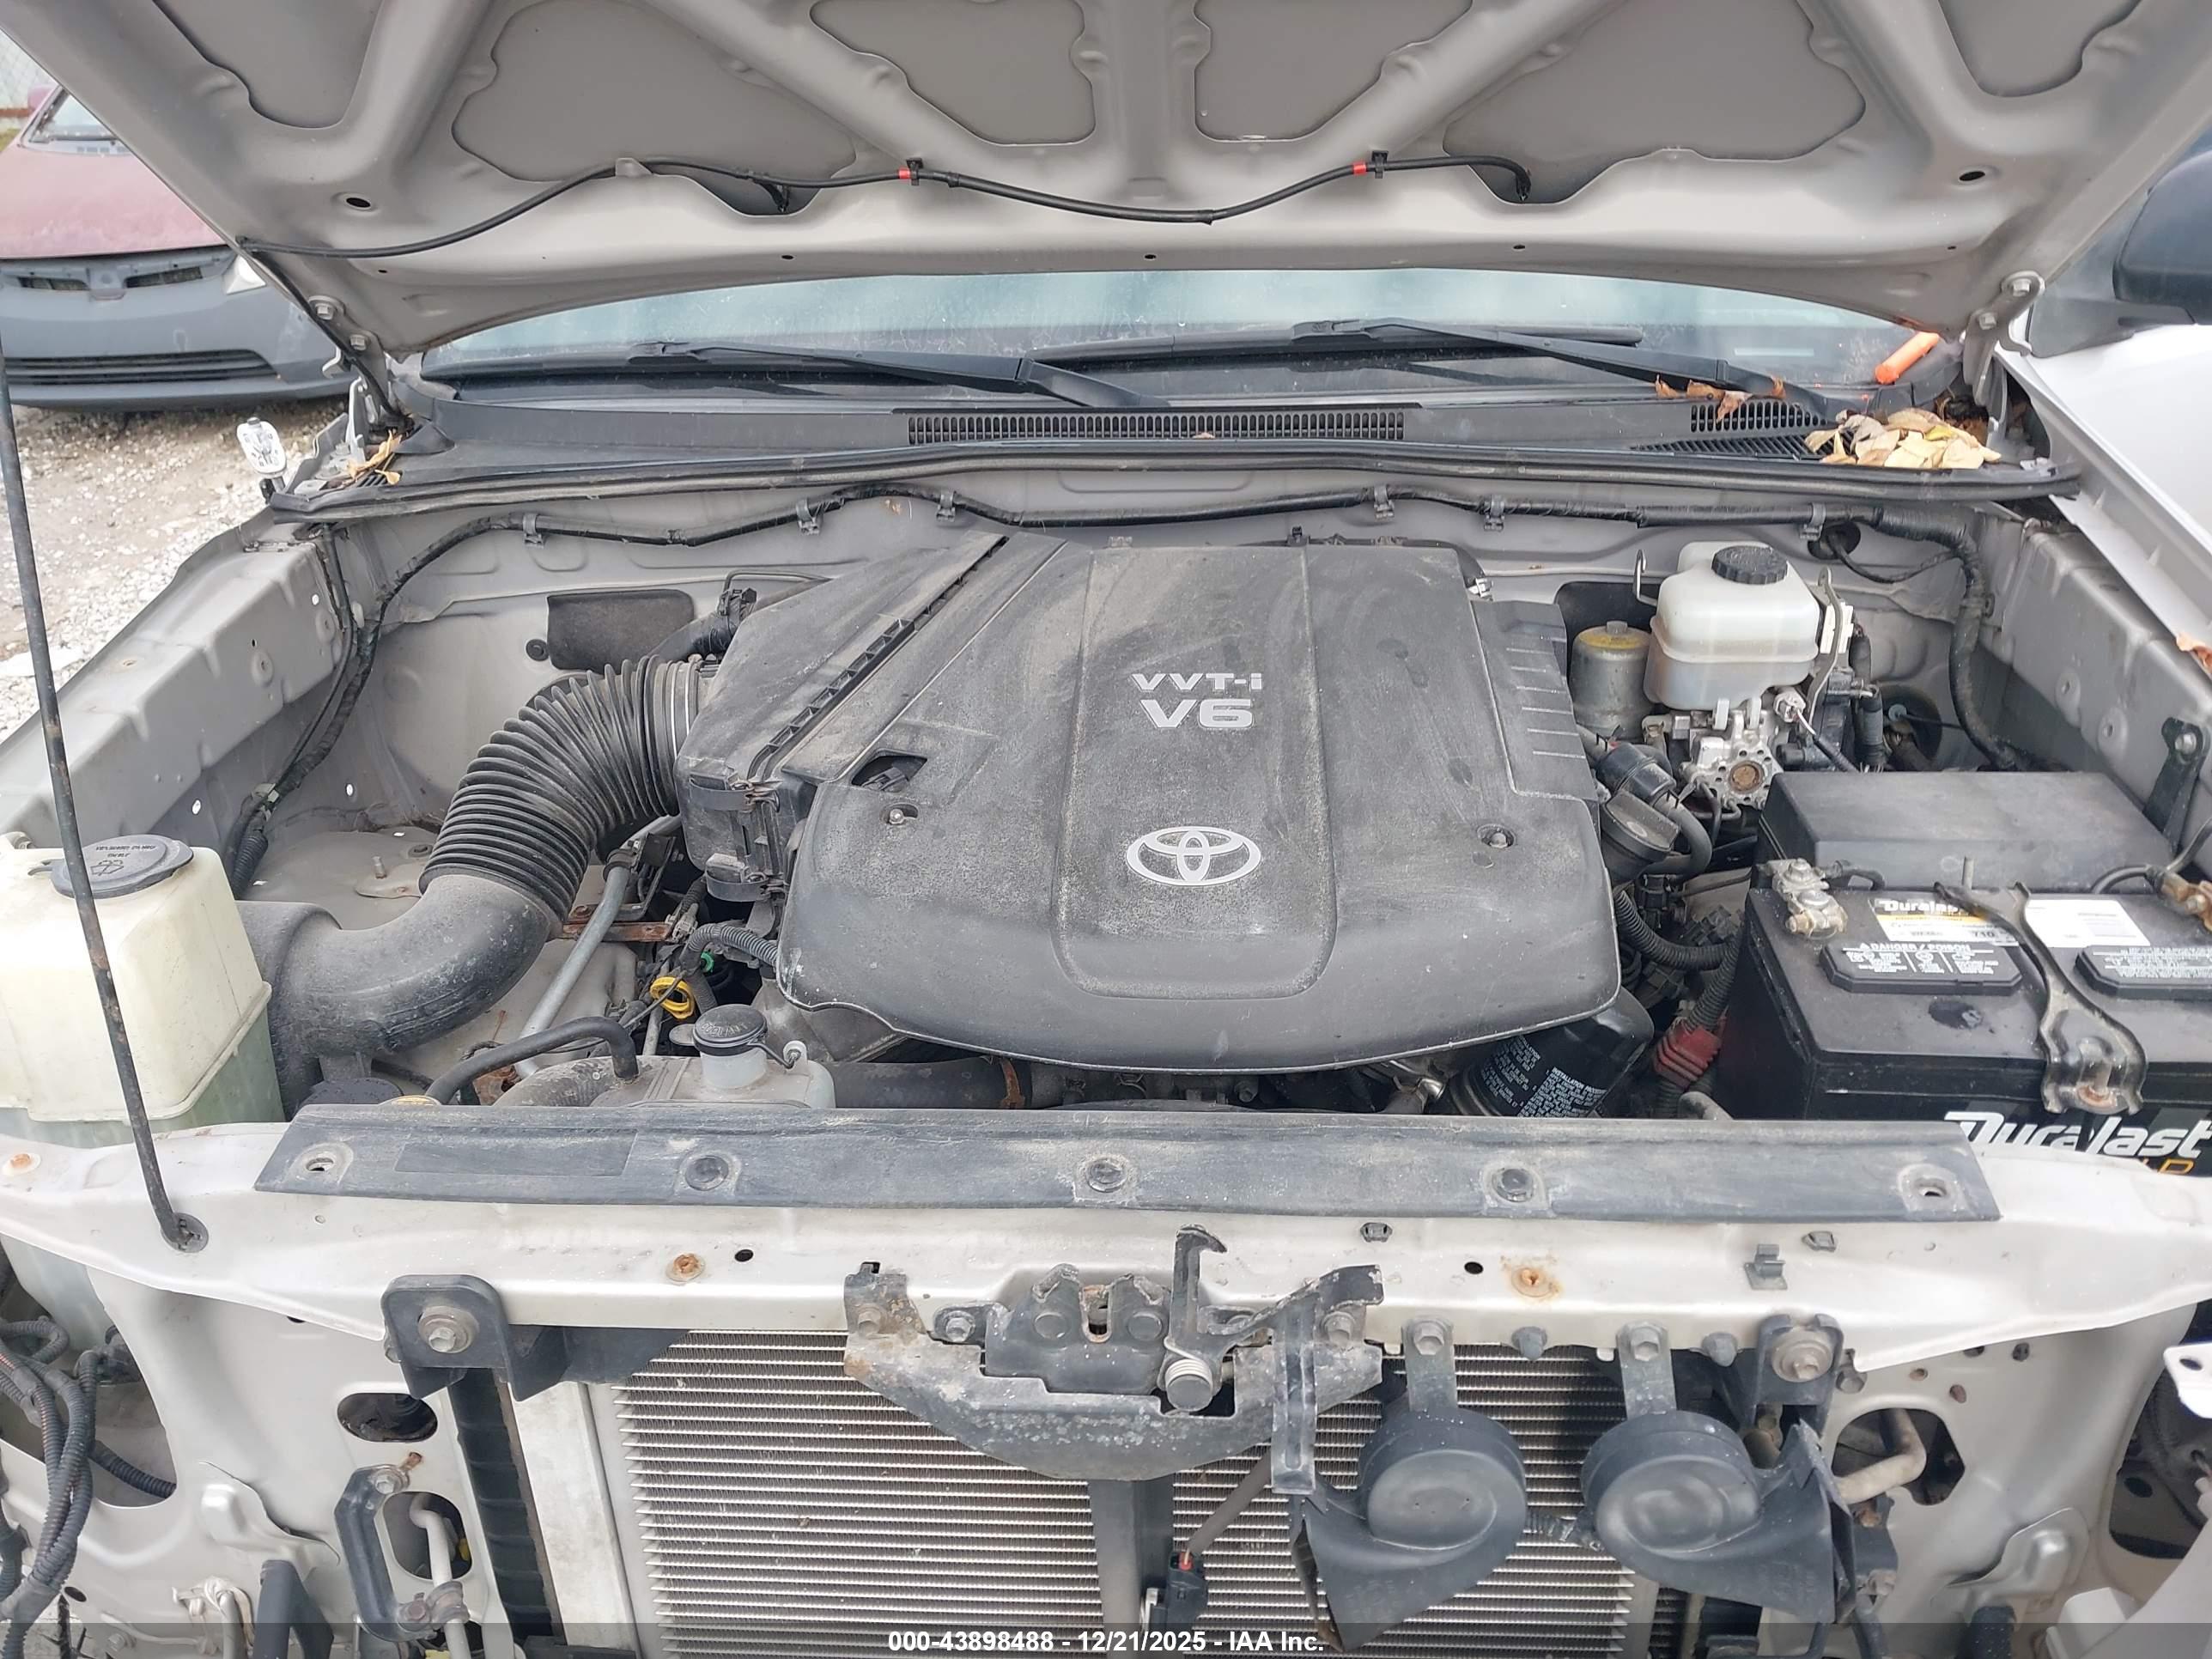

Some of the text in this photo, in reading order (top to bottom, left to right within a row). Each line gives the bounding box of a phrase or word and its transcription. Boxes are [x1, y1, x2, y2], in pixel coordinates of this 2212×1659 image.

[1132, 673, 1262, 690] VVT-i
[1140, 699, 1253, 728] V6
[1871, 943, 1917, 952] DANGER
[1944, 1111, 2212, 1158] Duralast
